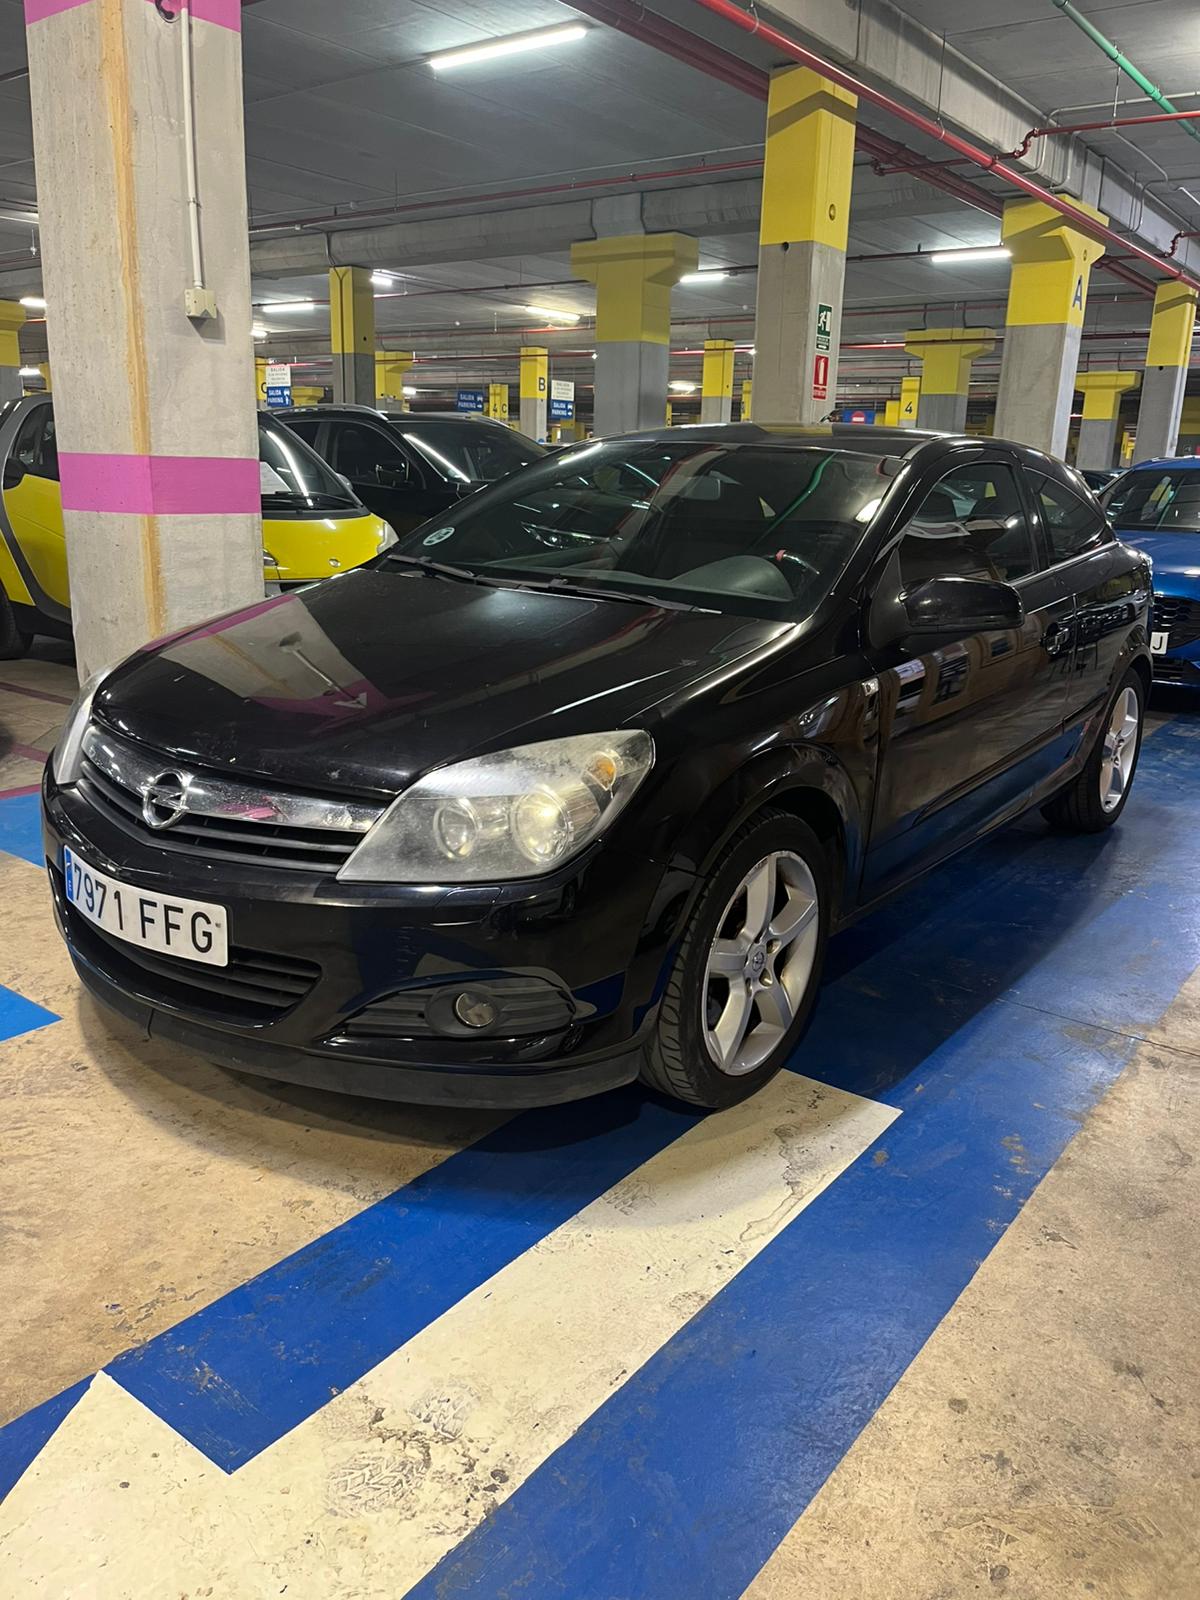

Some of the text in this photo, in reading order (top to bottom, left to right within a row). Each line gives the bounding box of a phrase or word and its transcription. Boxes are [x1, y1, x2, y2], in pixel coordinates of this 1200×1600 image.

[1072, 274, 1083, 311] A
[539, 377, 546, 391] B
[268, 389, 282, 397] SALIDA
[458, 401, 477, 409] PARKING
[553, 401, 567, 409] SALIDA
[905, 401, 913, 414] 4
[74, 862, 124, 931] 7971
[138, 897, 213, 954] FFG
